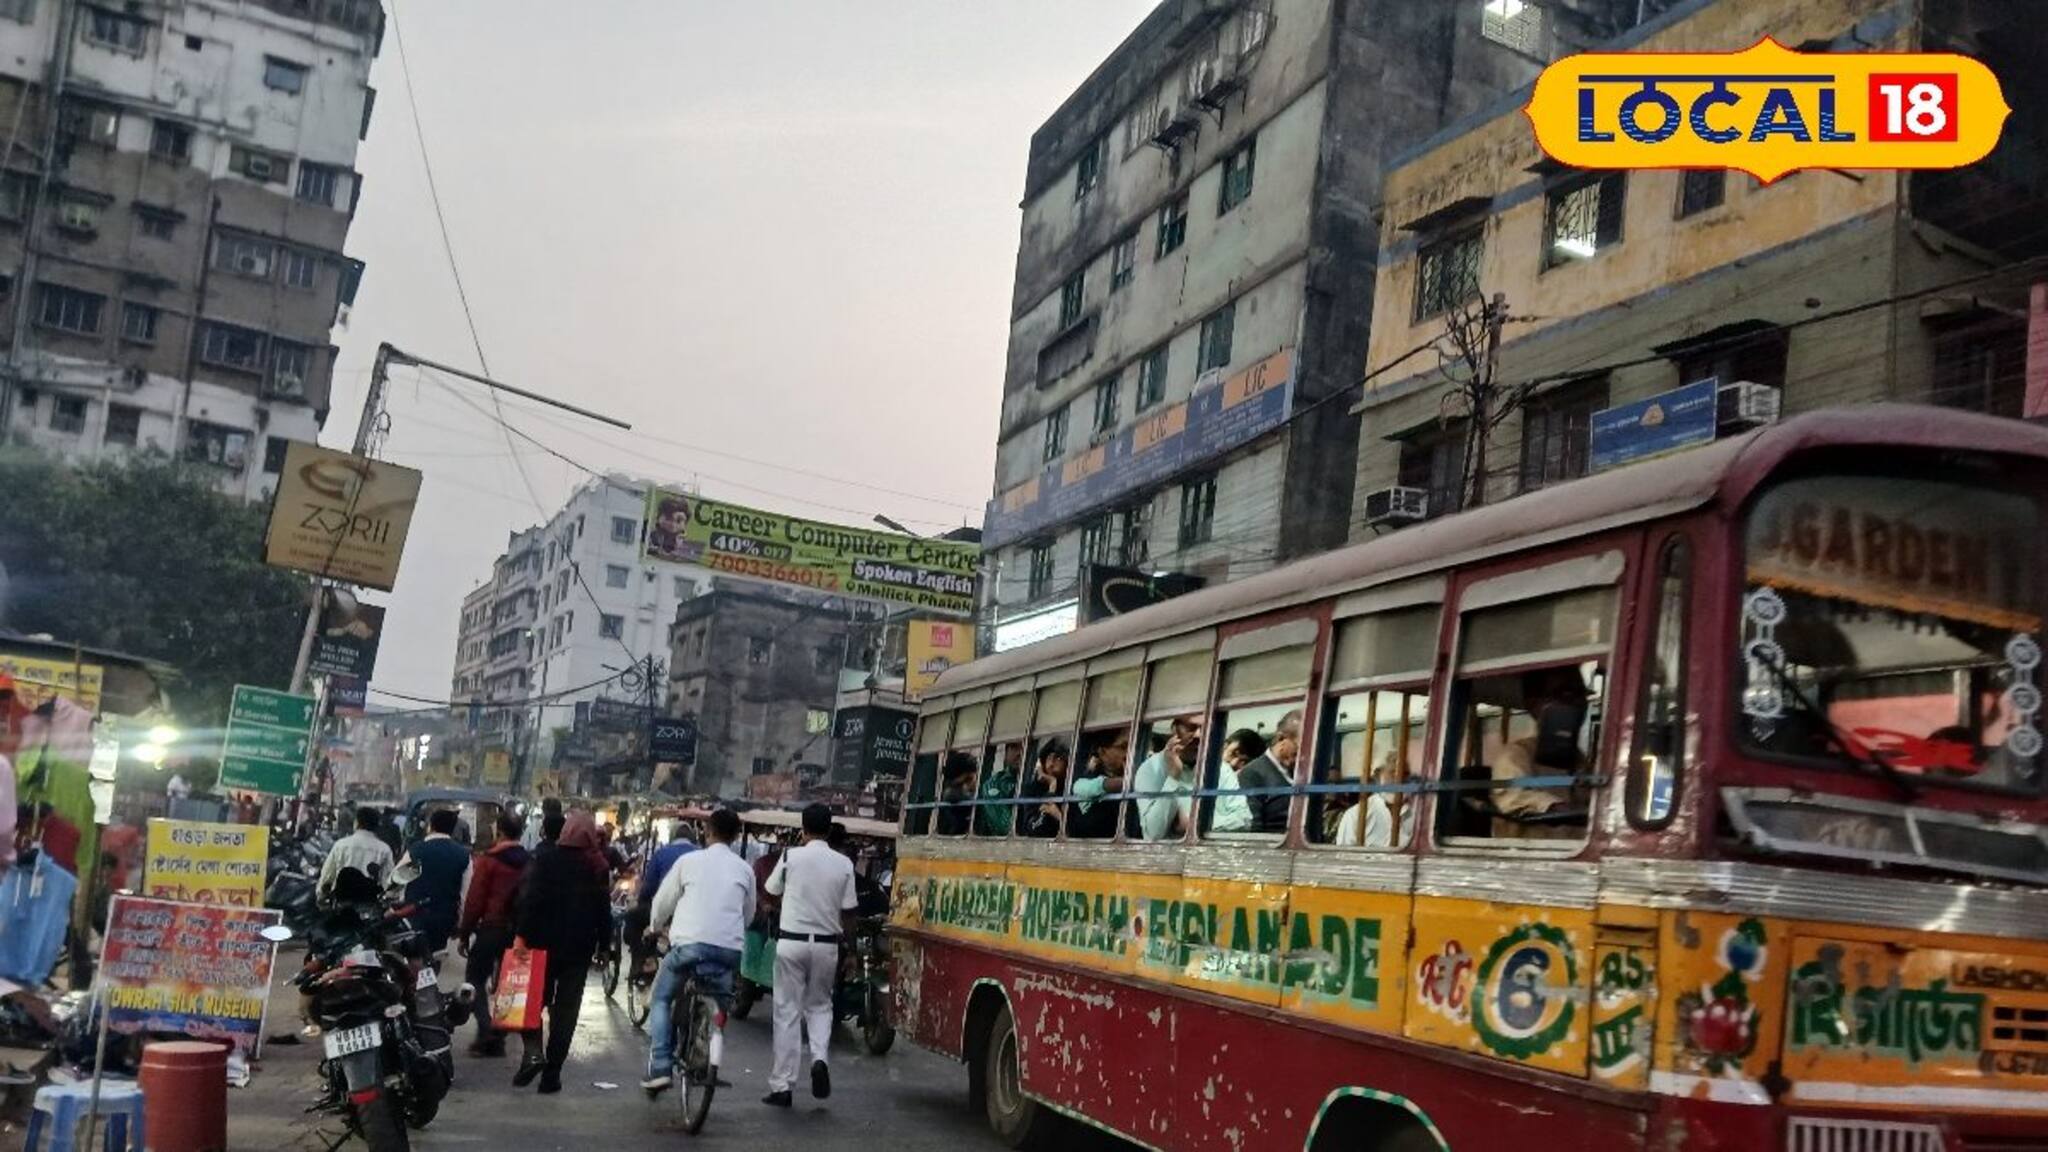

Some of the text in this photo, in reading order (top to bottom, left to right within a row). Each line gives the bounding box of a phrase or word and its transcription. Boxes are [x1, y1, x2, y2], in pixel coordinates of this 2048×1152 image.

[1244, 363, 1267, 396] LIC
[1149, 413, 1169, 442] LIC
[299, 503, 390, 545] ZORII
[694, 500, 979, 572] Career Computer Centre
[714, 534, 760, 557] 40%
[854, 559, 913, 585] Spoken
[916, 570, 973, 594] English
[857, 582, 915, 604] Mallick
[1021, 886, 1129, 956] HOWRAH
[1145, 898, 1382, 1004] ESPLANADE
[167, 991, 199, 1013] SILK
[202, 994, 262, 1018] MUSEUM
